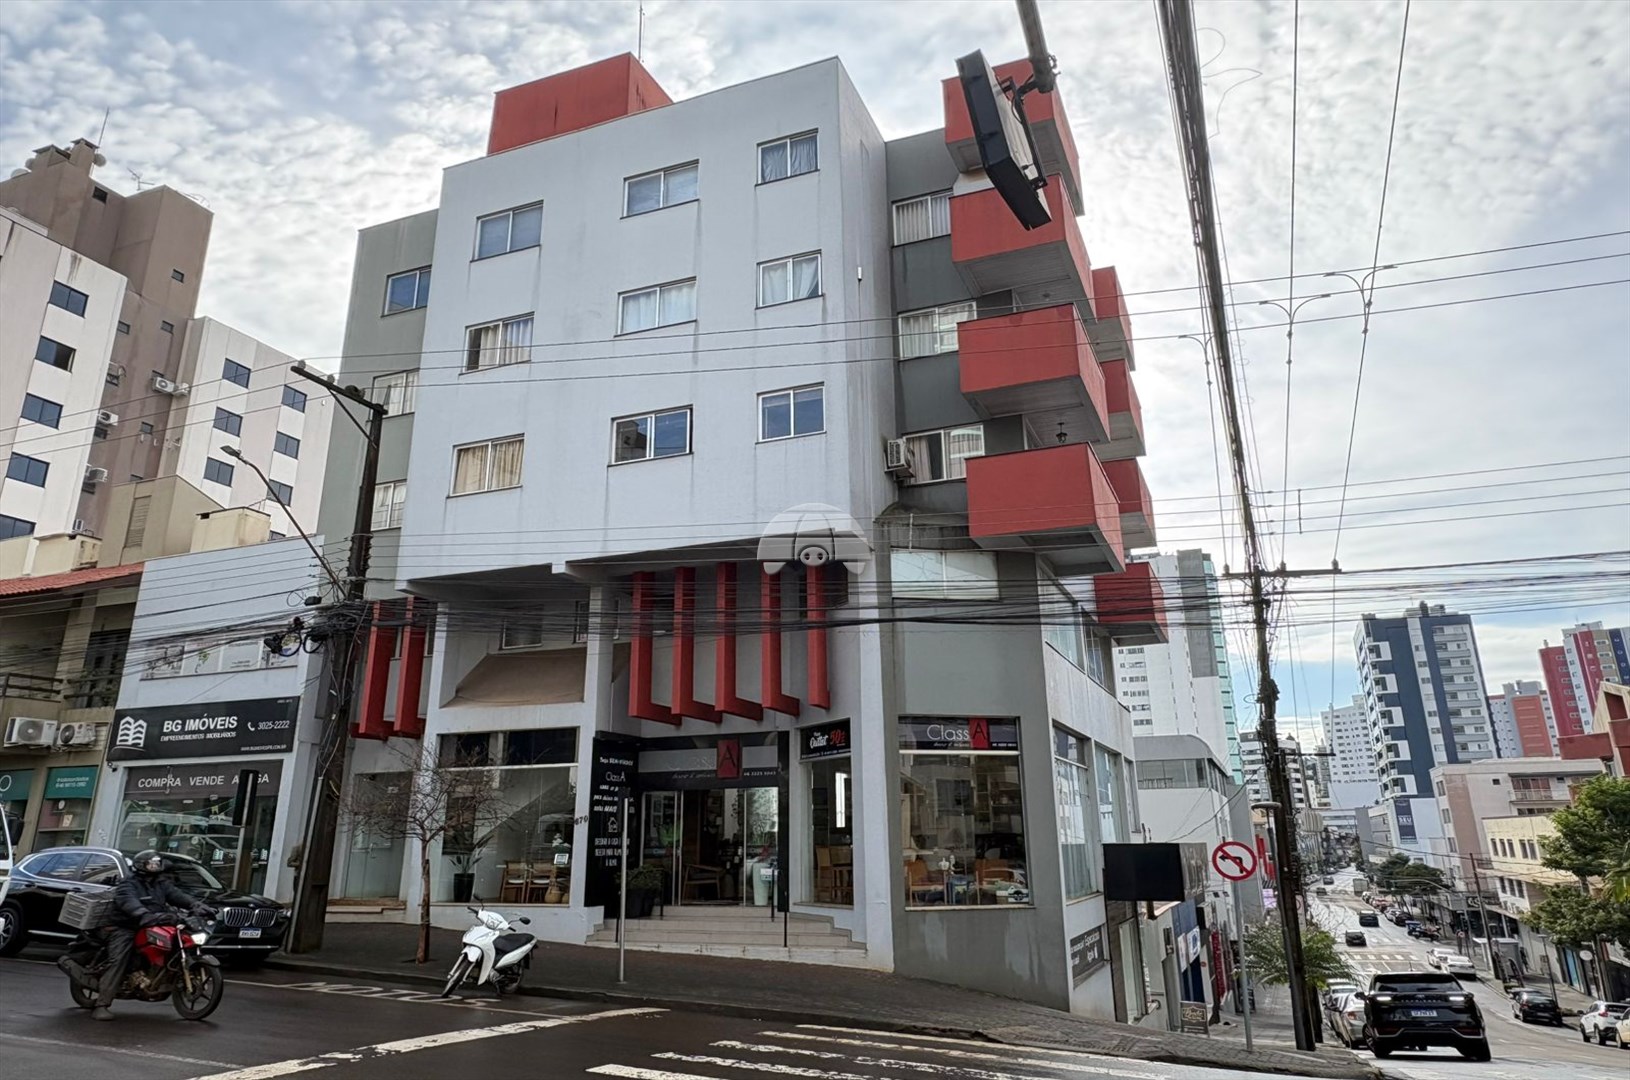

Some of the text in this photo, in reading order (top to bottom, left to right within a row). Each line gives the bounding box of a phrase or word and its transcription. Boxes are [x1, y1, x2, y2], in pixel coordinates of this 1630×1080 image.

[163, 713, 238, 732] BG IMÓVEIS
[257, 720, 290, 730] 3025-2222
[138, 777, 181, 788] COMPRA
[189, 775, 225, 786] VENDE
